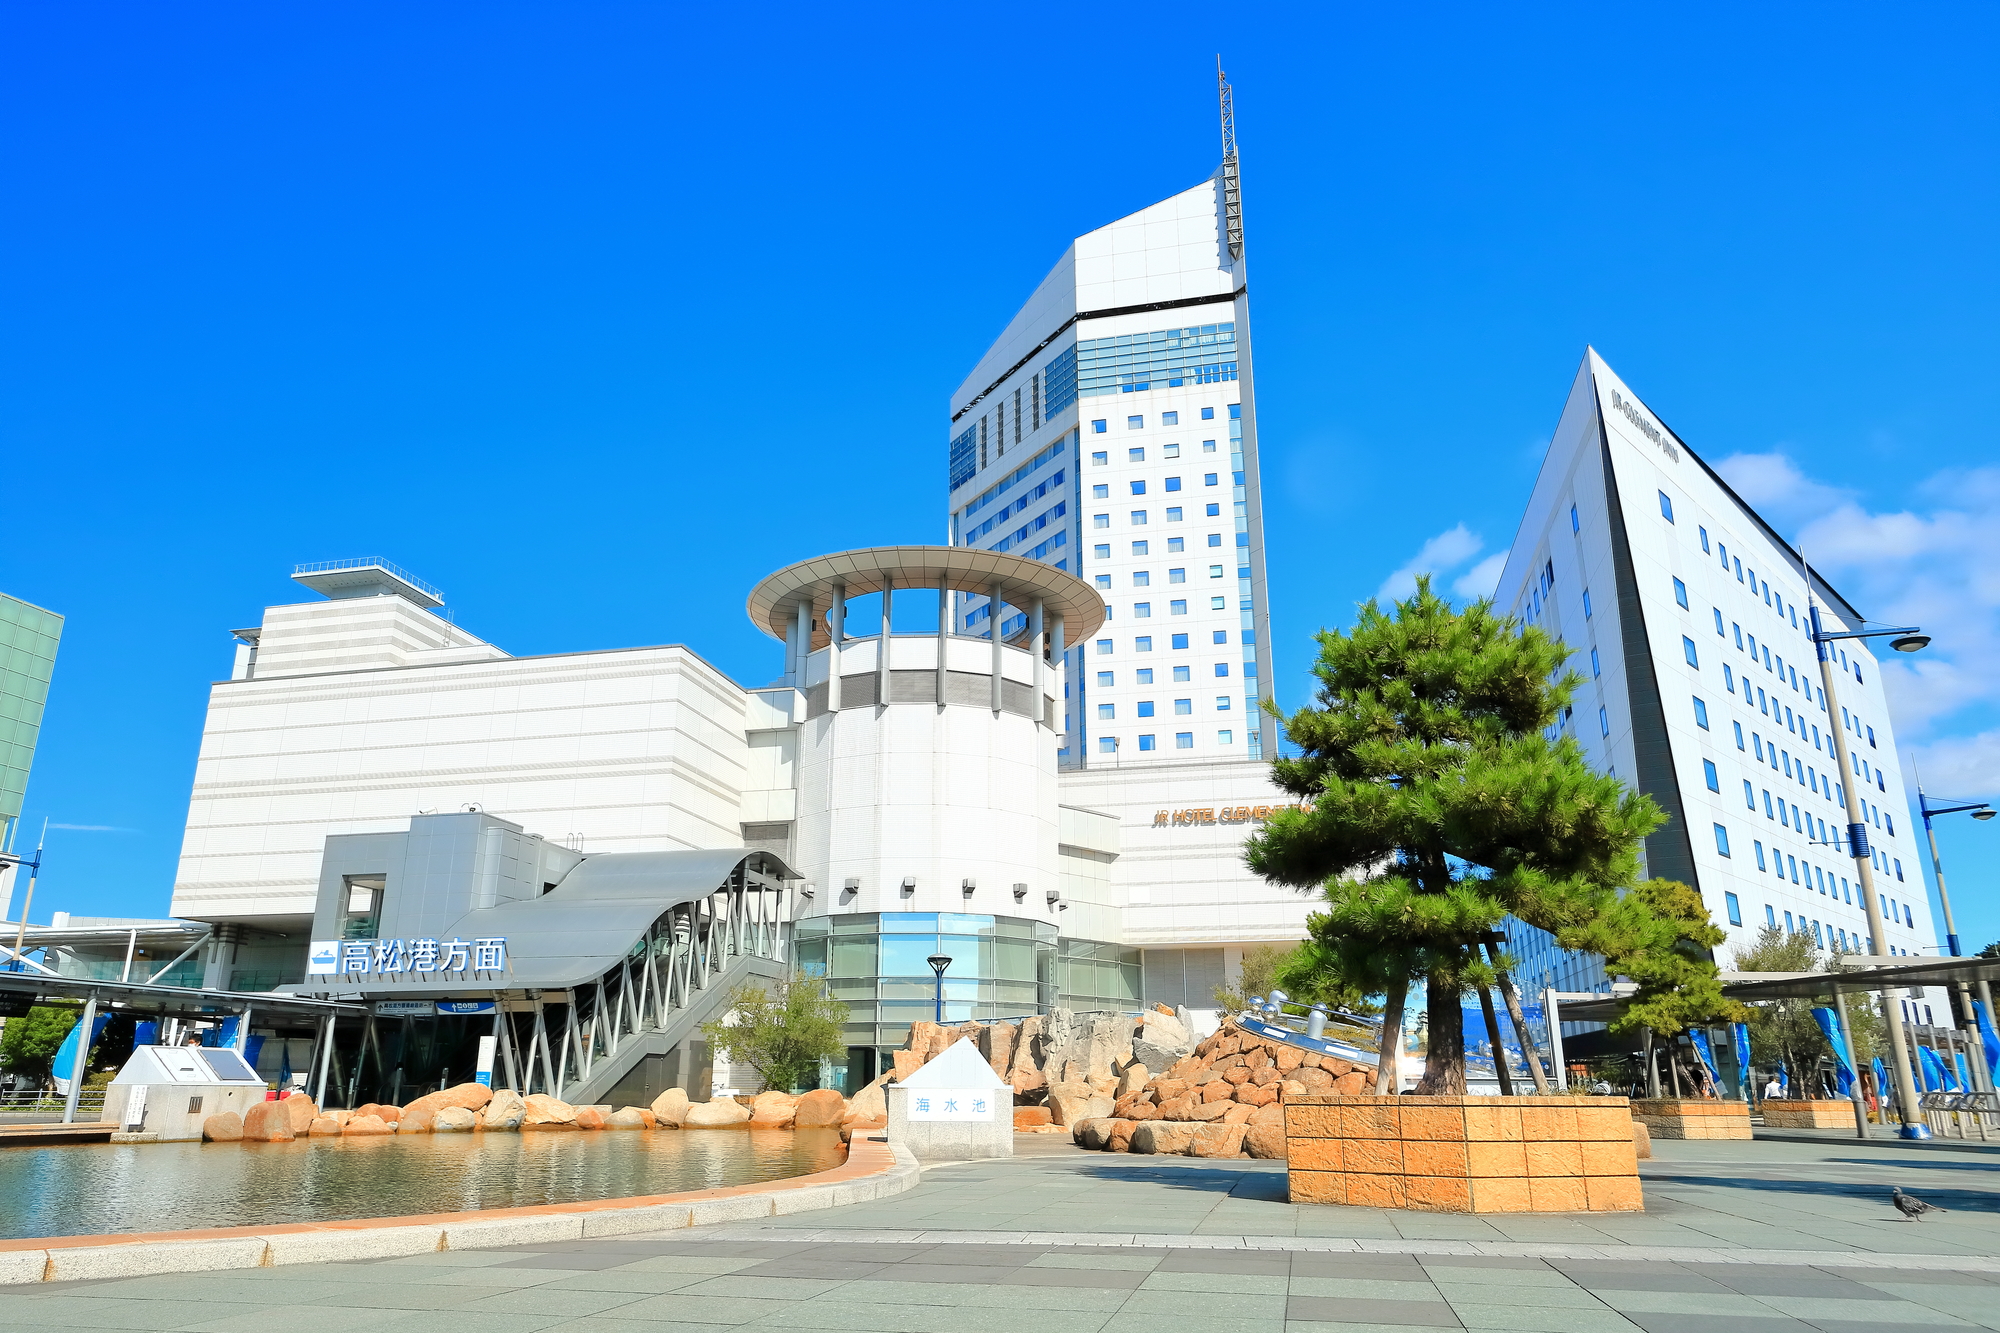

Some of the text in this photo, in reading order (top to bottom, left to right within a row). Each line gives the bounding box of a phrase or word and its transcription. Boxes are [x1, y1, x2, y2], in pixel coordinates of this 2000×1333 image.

[1156, 809, 1169, 823] JR
[1174, 807, 1218, 822] HOTEL
[342, 937, 507, 974] 高松港方面
[916, 1097, 987, 1113] 海水池
